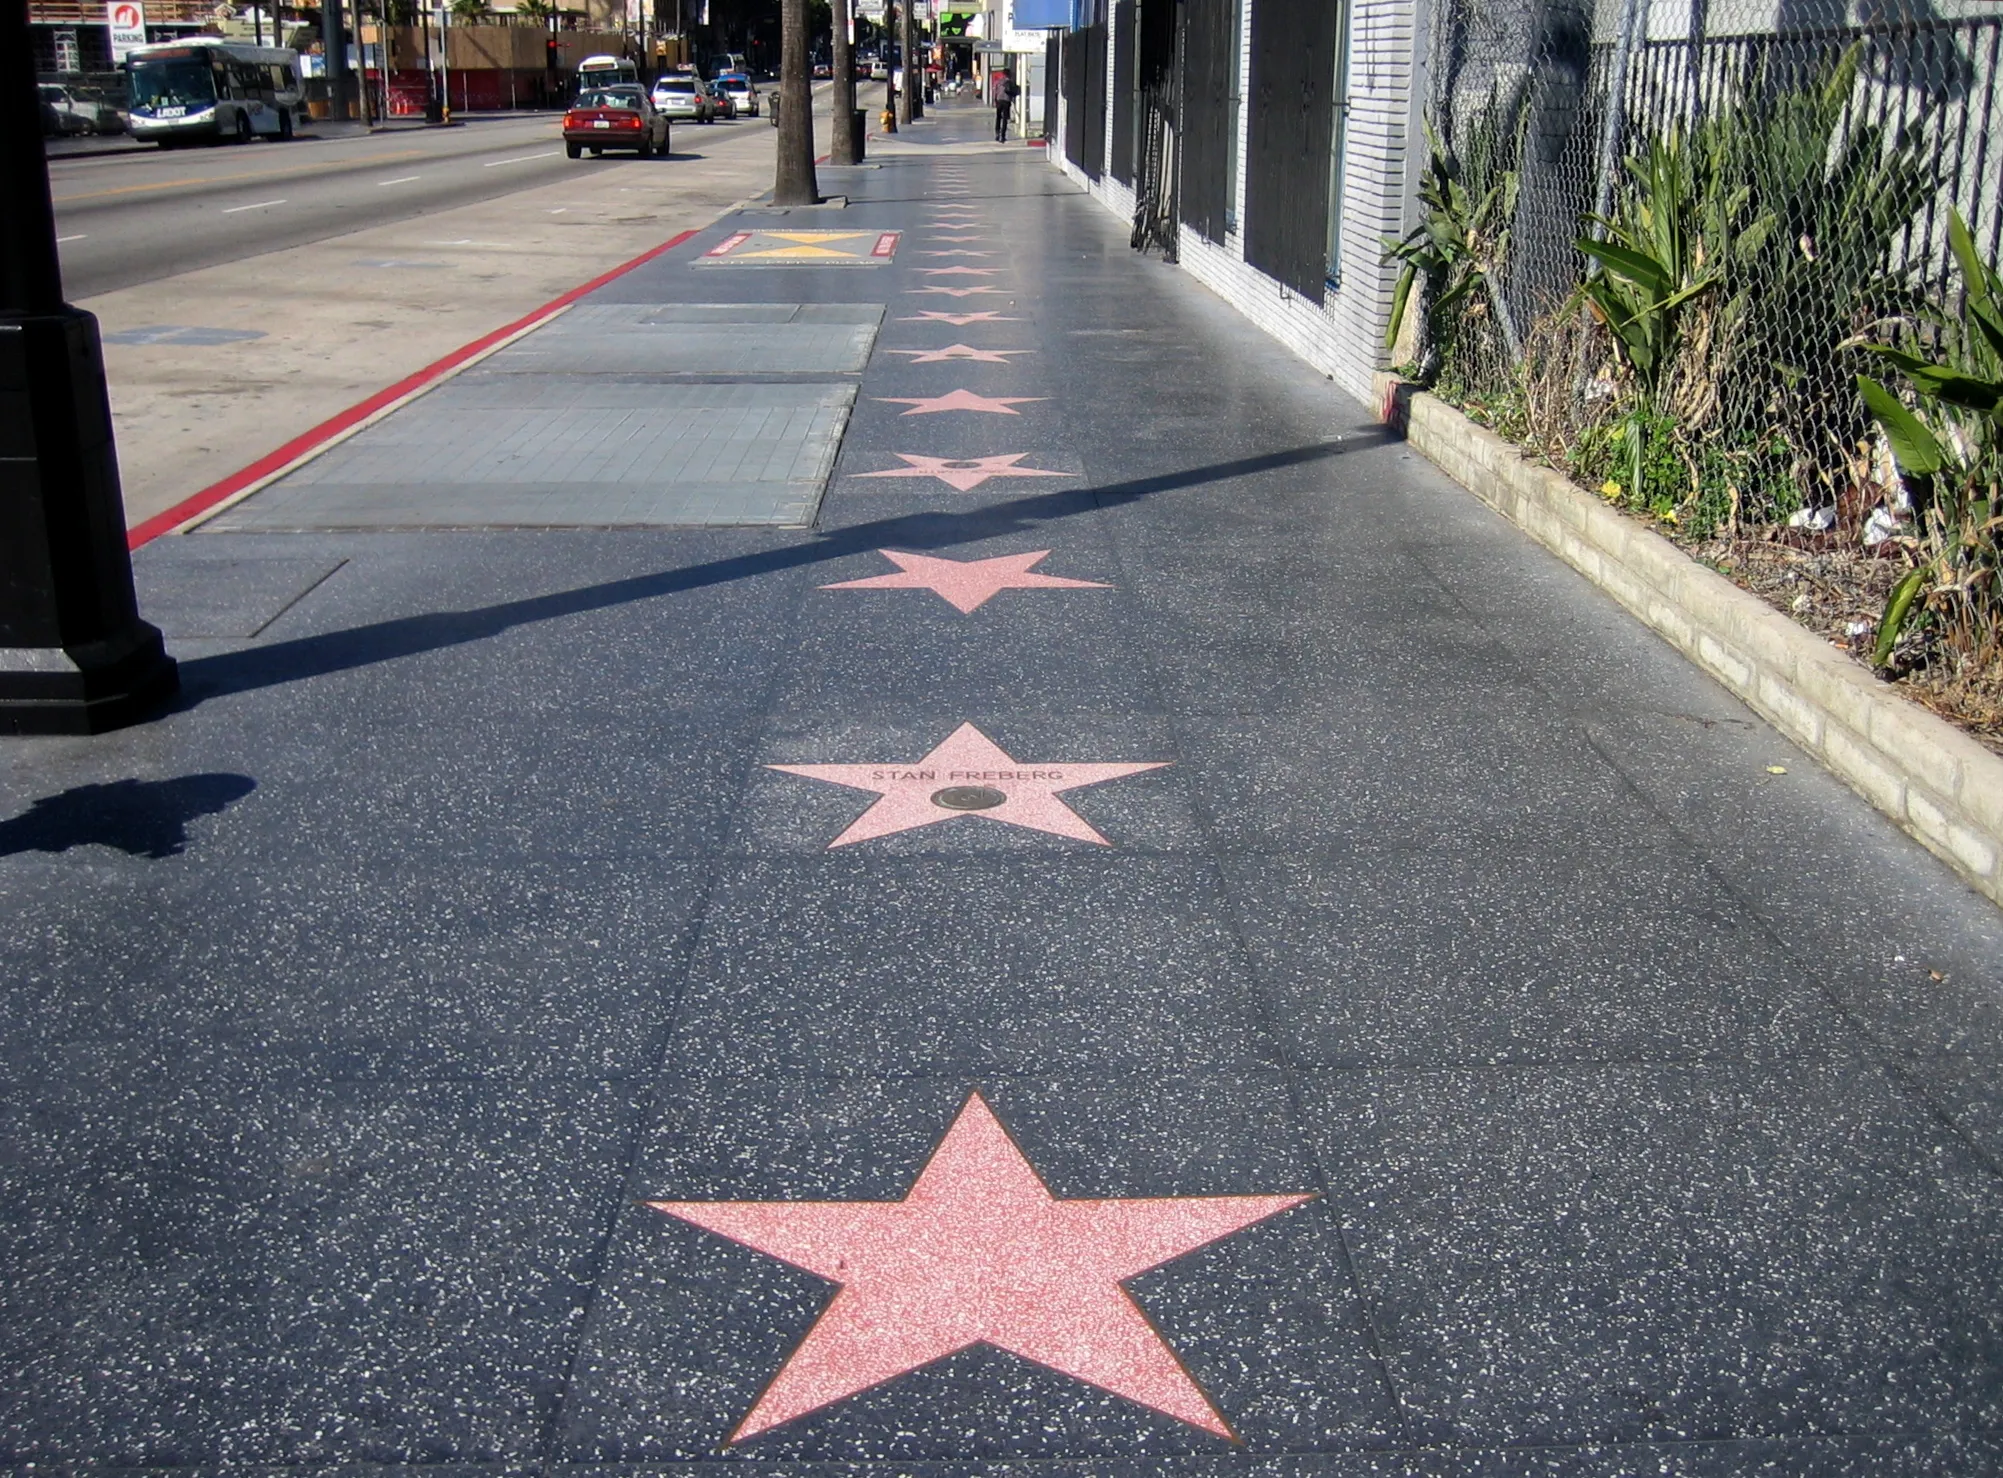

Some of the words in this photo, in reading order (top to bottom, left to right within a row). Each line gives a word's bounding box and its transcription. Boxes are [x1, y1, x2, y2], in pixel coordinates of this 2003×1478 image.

[113, 33, 144, 43] PARKING
[872, 770, 935, 780] STAN
[949, 770, 1063, 780] FREBERG
